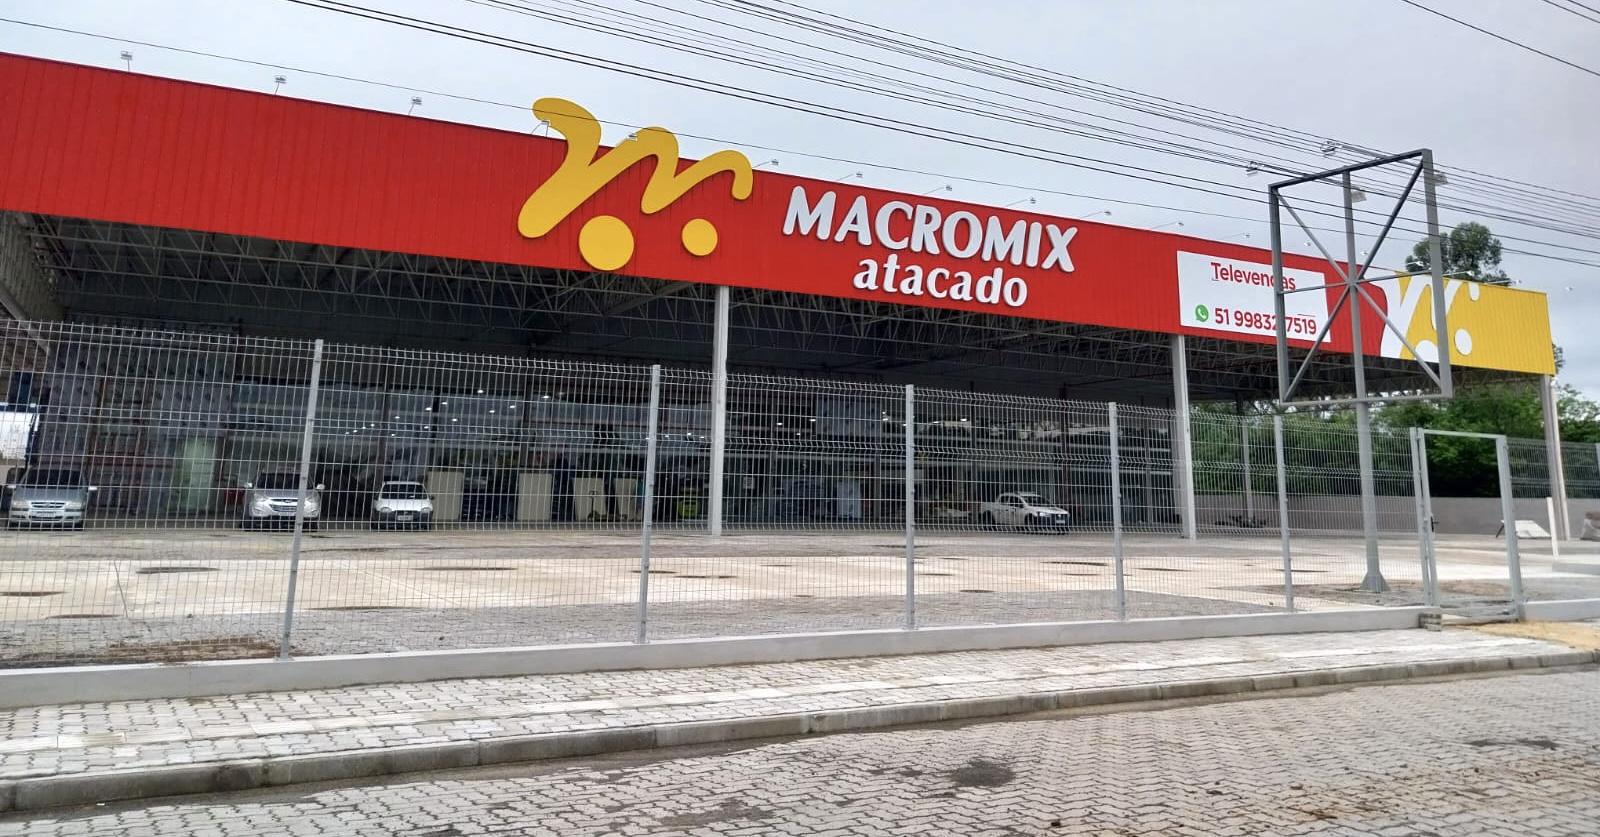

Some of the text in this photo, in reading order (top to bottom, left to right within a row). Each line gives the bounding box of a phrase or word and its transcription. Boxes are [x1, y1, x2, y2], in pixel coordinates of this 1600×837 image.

[782, 185, 1079, 273] MACROMIX
[853, 253, 1028, 307] atacado
[1214, 307, 1230, 325] 51
[1285, 316, 1317, 335] 7519
